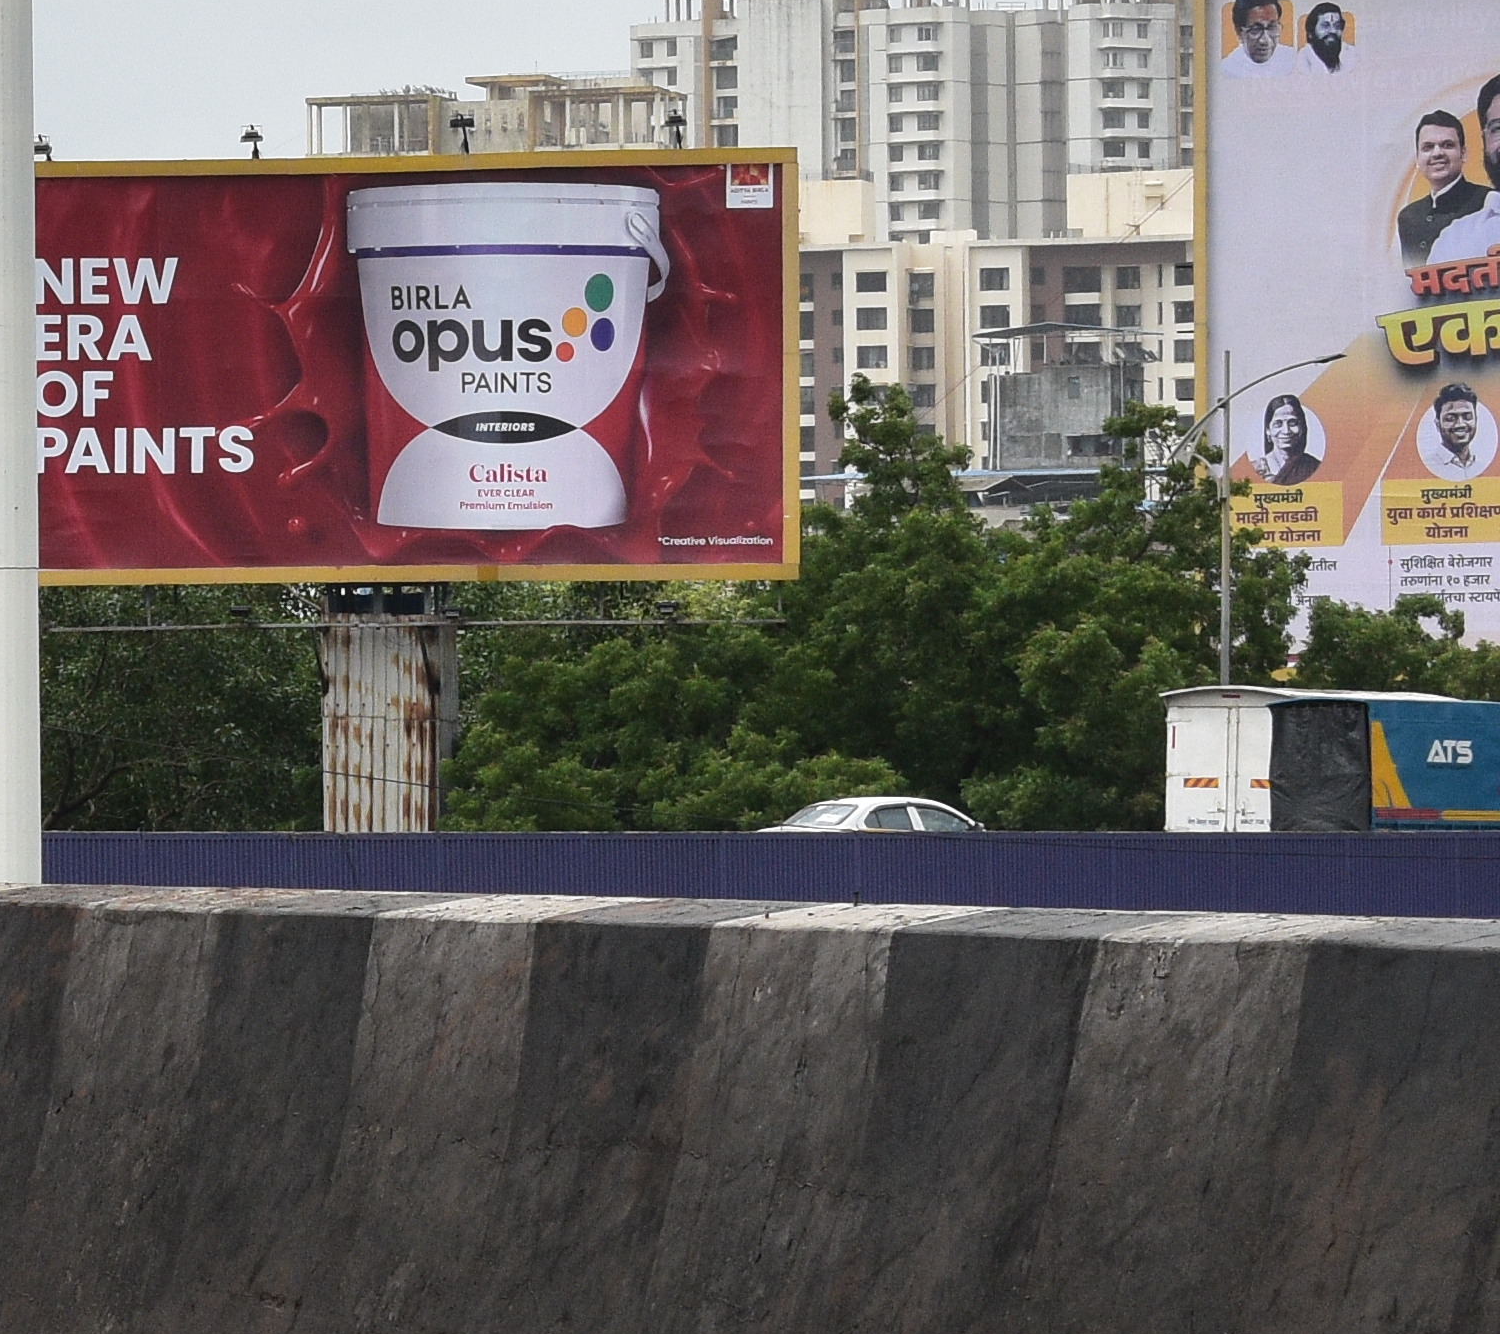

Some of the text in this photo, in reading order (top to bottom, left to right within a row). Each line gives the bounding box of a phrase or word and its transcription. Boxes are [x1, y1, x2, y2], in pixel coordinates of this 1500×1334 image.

[35, 257, 179, 305] NEW
[390, 284, 472, 311] BIRLA
[35, 314, 152, 362] ERA
[461, 372, 553, 394] PAINTS
[36, 370, 114, 418] OF
[475, 422, 536, 432] INTERIORS
[36, 425, 254, 475] PAINTS
[468, 463, 548, 484] Calista
[477, 488, 535, 498] EVER CLEAR
[1253, 489, 1304, 509] मुख्यमंत्री
[1420, 484, 1473, 505] मुख्यमंत्री
[459, 500, 553, 511] Premium Emulsion
[1235, 506, 1319, 526] माझी लाडकी
[1386, 507, 1413, 525] युवा
[1416, 503, 1447, 519] कार्य
[707, 535, 774, 546] Visualization
[1278, 527, 1322, 542] योजना
[1425, 522, 1469, 539] योजना
[1463, 574, 1491, 587] हजार
[1426, 739, 1474, 764] ATS
